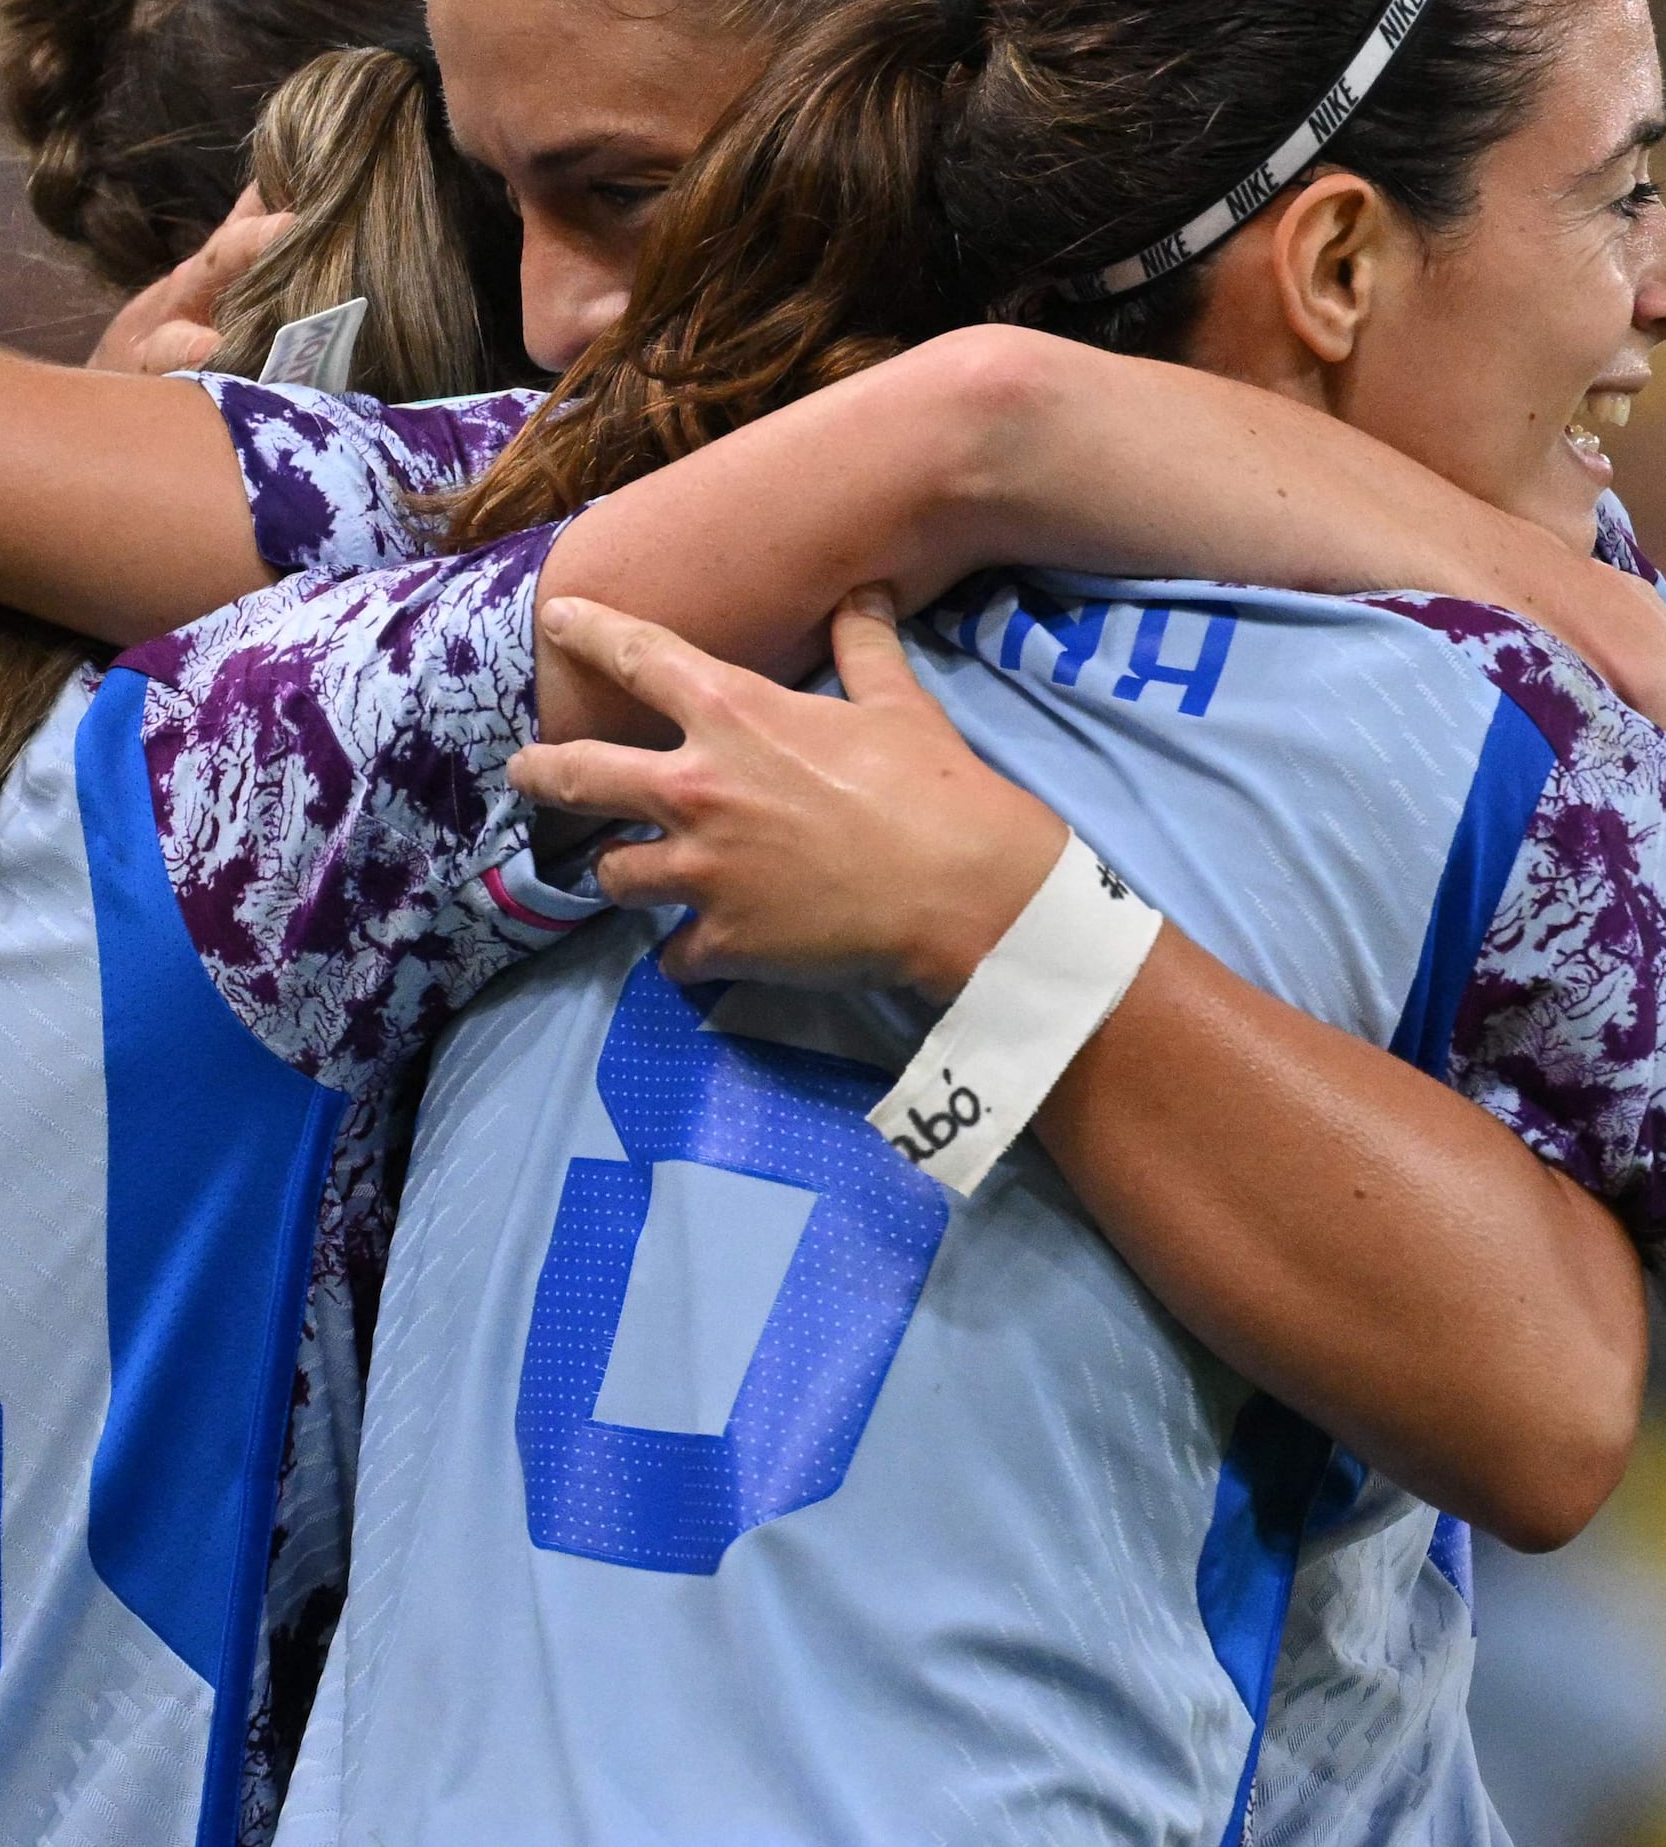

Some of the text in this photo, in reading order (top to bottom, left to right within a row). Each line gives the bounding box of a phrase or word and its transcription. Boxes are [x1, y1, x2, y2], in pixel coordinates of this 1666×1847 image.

[1139, 229, 1192, 279] NIKE
[1226, 162, 1281, 224] NIKE
[1308, 75, 1360, 145] NIKE
